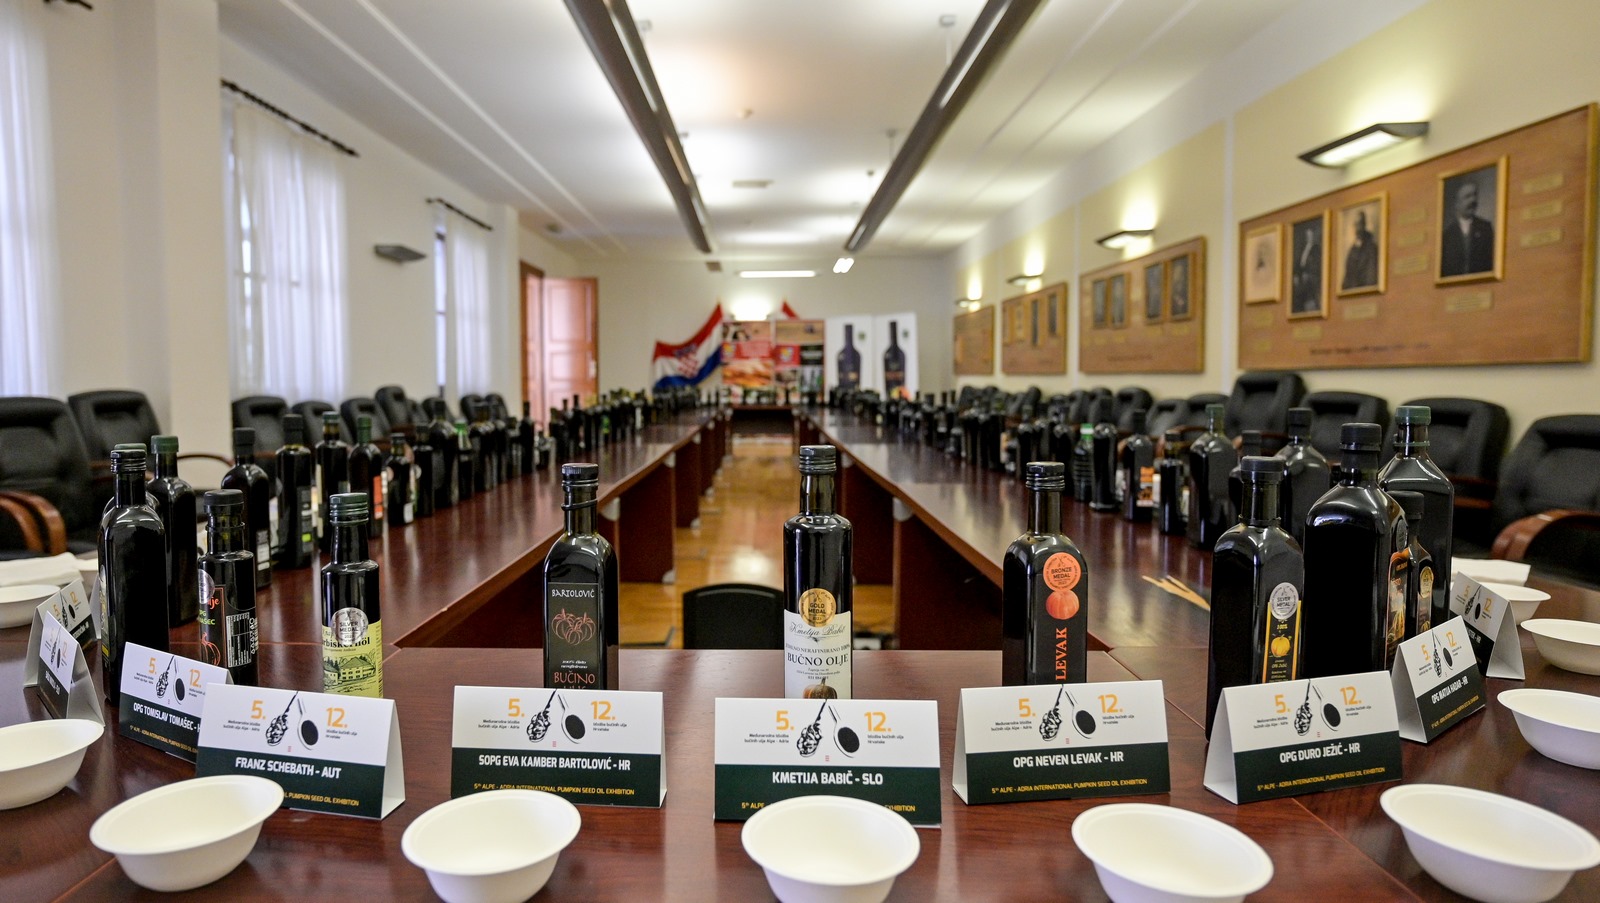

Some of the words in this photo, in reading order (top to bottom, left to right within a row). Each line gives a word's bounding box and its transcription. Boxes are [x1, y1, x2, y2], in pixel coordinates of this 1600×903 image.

[552, 589, 594, 598] BARTOLOVIĆ
[788, 652, 822, 666] BUČNO
[826, 654, 848, 666] OLJE
[1056, 627, 1067, 680] LEVAK
[190, 669, 201, 688] 12.
[554, 671, 595, 684] BUČINO
[1098, 694, 1123, 713] 12.
[1274, 694, 1290, 713] 5.
[1340, 686, 1362, 705] 12.
[134, 702, 143, 713] OPG
[144, 706, 168, 722] TOMISLAV
[169, 716, 193, 730] TOMAŠEC
[251, 700, 266, 720] 5.
[508, 698, 525, 717] 5.
[591, 701, 616, 721] 12.
[1018, 698, 1036, 717] 5.
[326, 707, 348, 728] 12.
[776, 710, 794, 731] 5.
[864, 712, 891, 732] 12.
[479, 754, 501, 766] SOPG
[502, 756, 519, 767] EVA
[521, 756, 557, 768] KAMBER
[559, 755, 612, 770] BARTOLOVIĆ
[618, 759, 631, 770] HR
[1014, 756, 1033, 768] OPG
[1036, 754, 1069, 766] NEVEN
[1071, 753, 1102, 764] LEVAK
[1110, 751, 1124, 762] HR
[1280, 752, 1297, 763] OPG
[1298, 750, 1321, 761] ĐURO
[1322, 743, 1342, 759] JEŽIĆ
[1349, 743, 1360, 754] HR
[235, 757, 265, 770] FRANZ
[267, 760, 314, 776] SCHEBATH
[321, 766, 341, 778] AUT
[772, 772, 819, 784] KMETIJA
[821, 770, 853, 785] BABIČ
[862, 773, 883, 785] SLO
[332, 798, 359, 806] EXHIBITION
